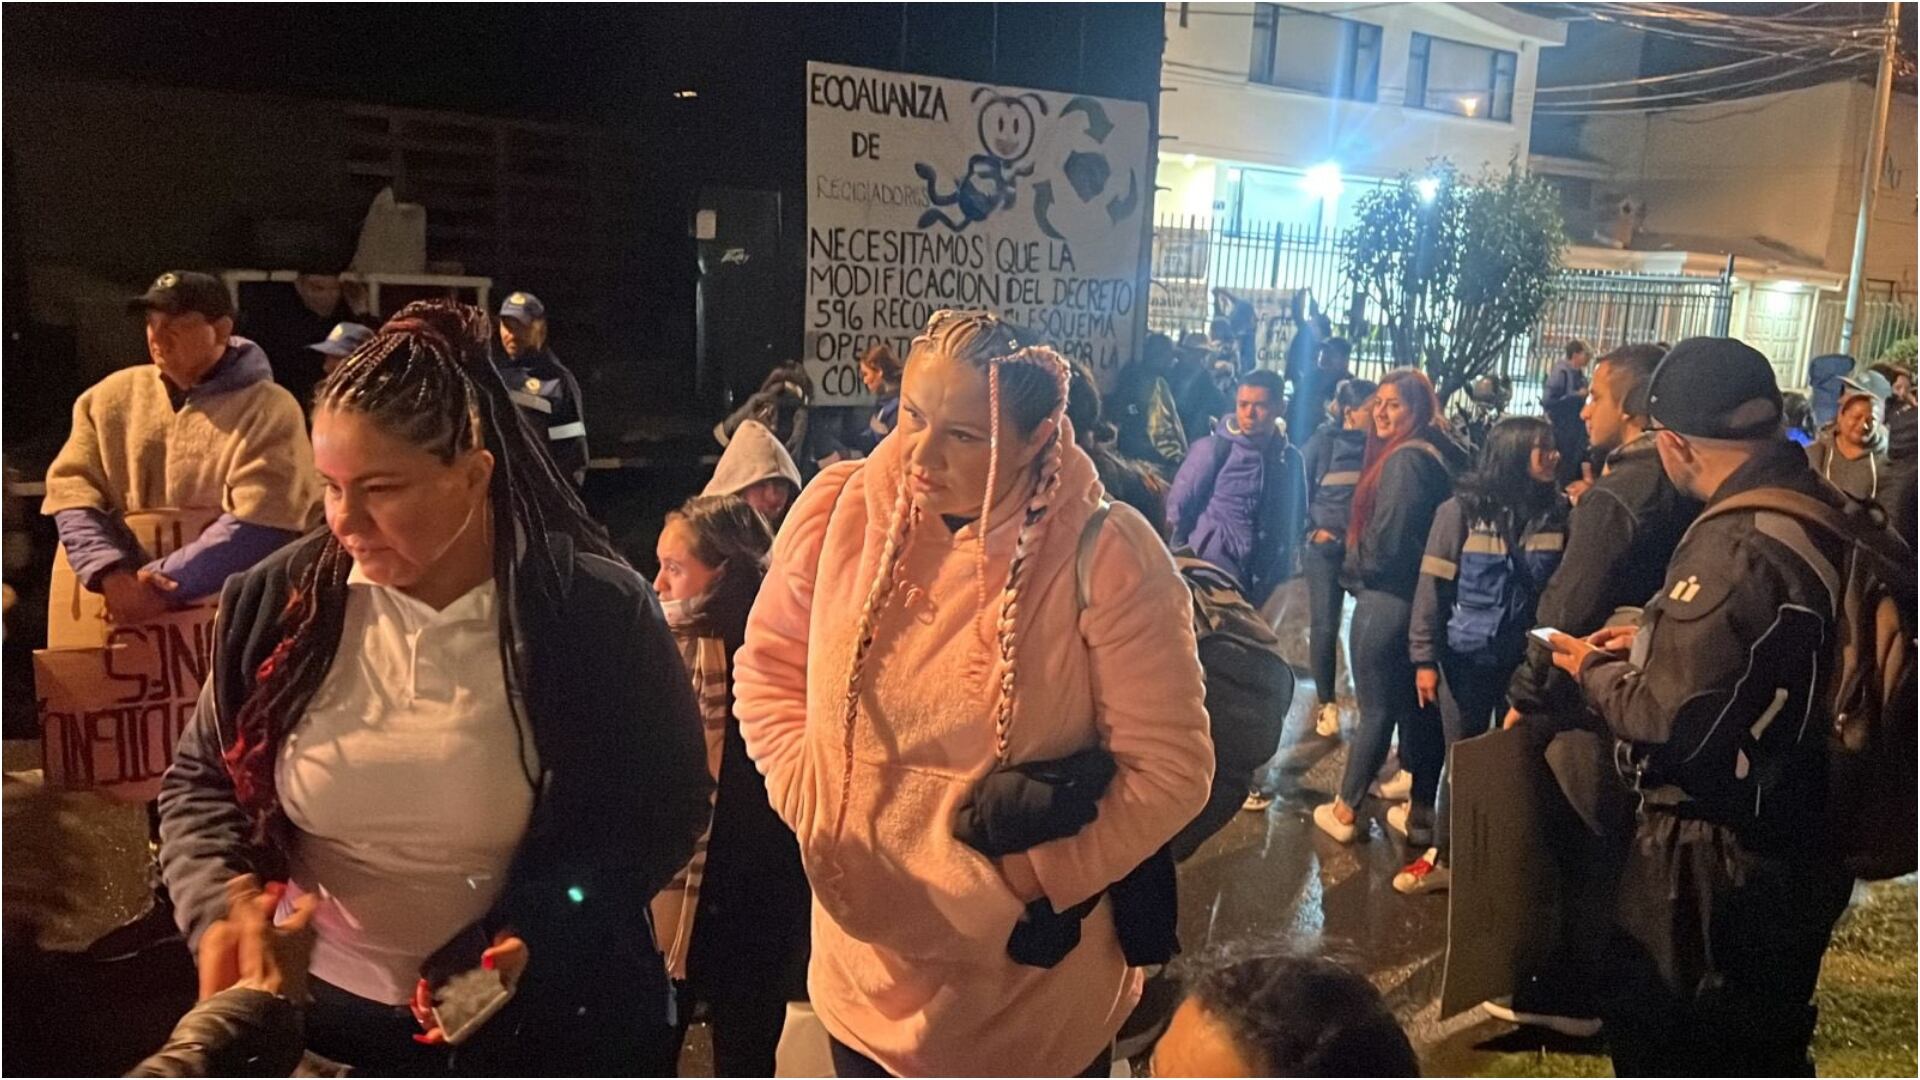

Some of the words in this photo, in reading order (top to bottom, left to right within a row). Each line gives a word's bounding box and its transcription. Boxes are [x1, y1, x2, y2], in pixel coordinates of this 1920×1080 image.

[852, 132, 880, 160] DE
[811, 227, 984, 269] NECESITAMOS
[996, 237, 1040, 275] QUE
[1049, 239, 1075, 272] LA
[810, 264, 1000, 306] MODIFICACION
[1007, 277, 1044, 305] DEL
[1053, 278, 1132, 316] DECRETO
[814, 299, 863, 330] 596
[1063, 340, 1094, 369] POR
[1100, 345, 1119, 370] LA
